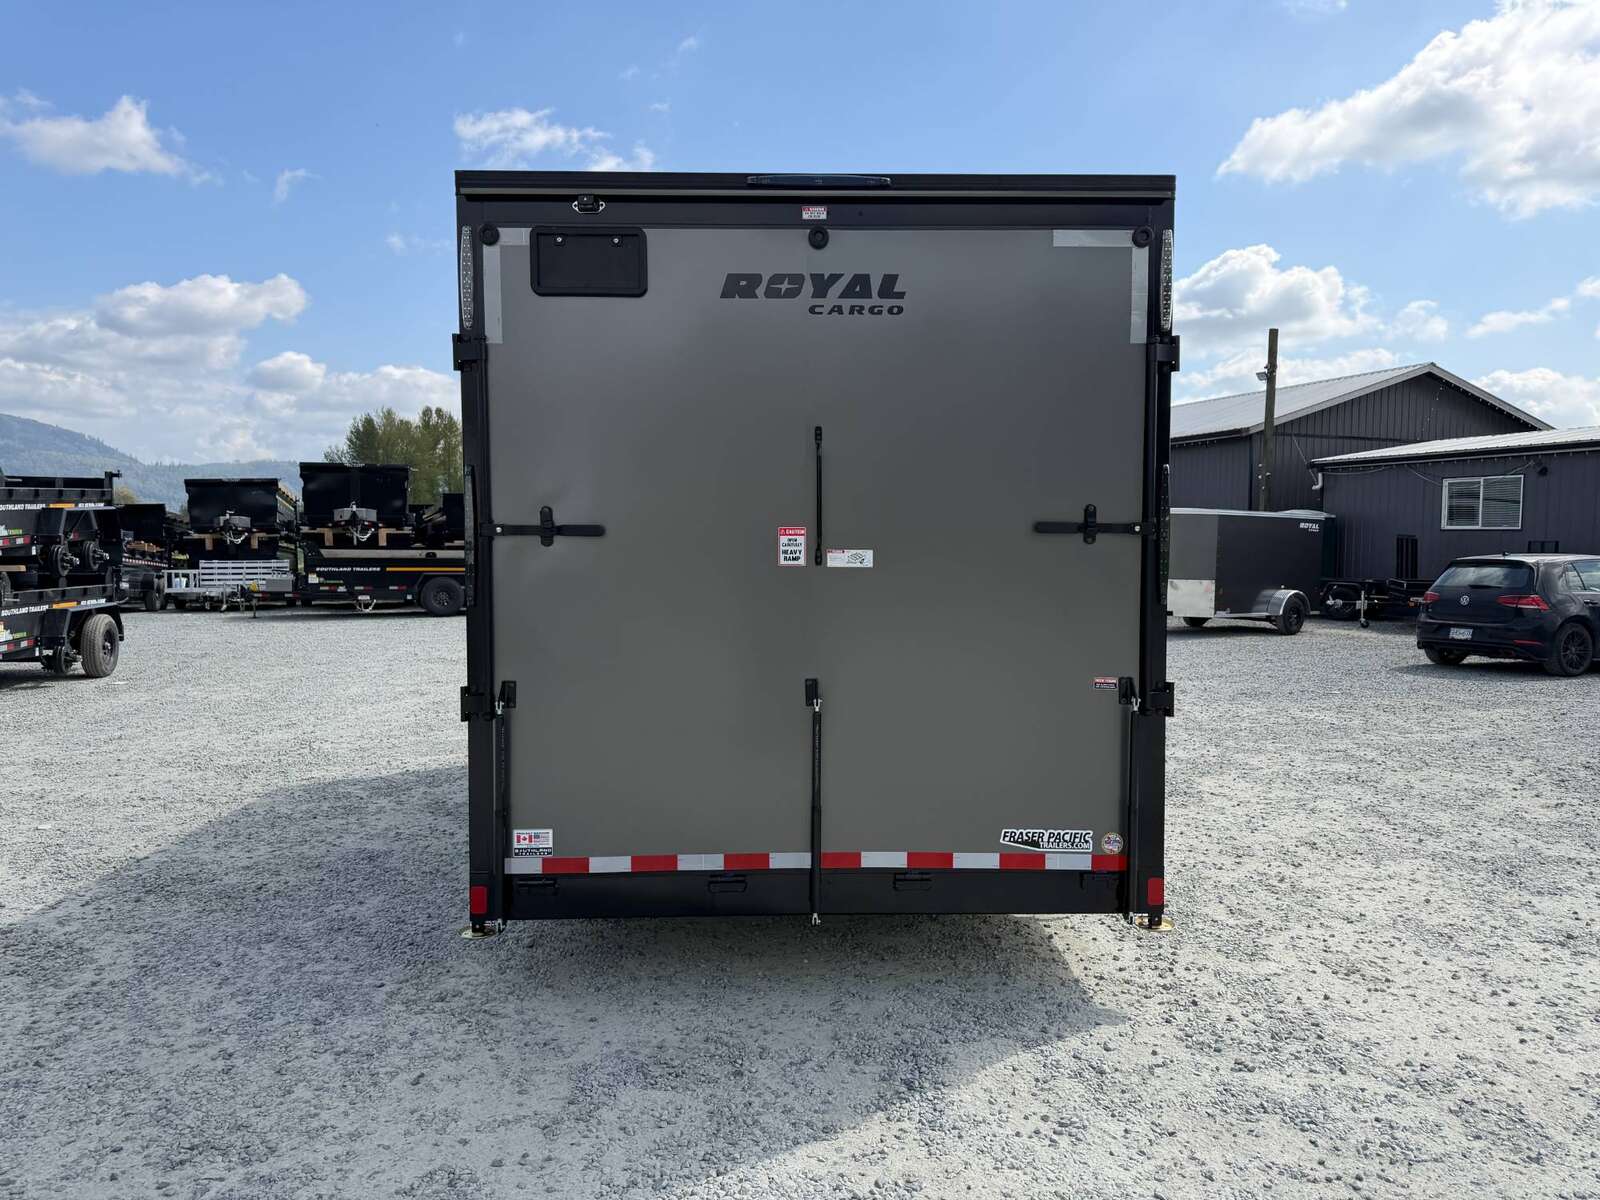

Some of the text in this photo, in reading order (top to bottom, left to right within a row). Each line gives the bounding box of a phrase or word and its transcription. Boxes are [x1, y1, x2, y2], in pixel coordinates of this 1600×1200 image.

[719, 273, 906, 300] ROYAL
[808, 304, 905, 315] CARGO
[1, 607, 29, 617] SOUTHLAND
[1002, 831, 1045, 842] FRASER
[1047, 831, 1092, 843] PACIFIC
[1040, 841, 1090, 849] TRAILERS.COM
